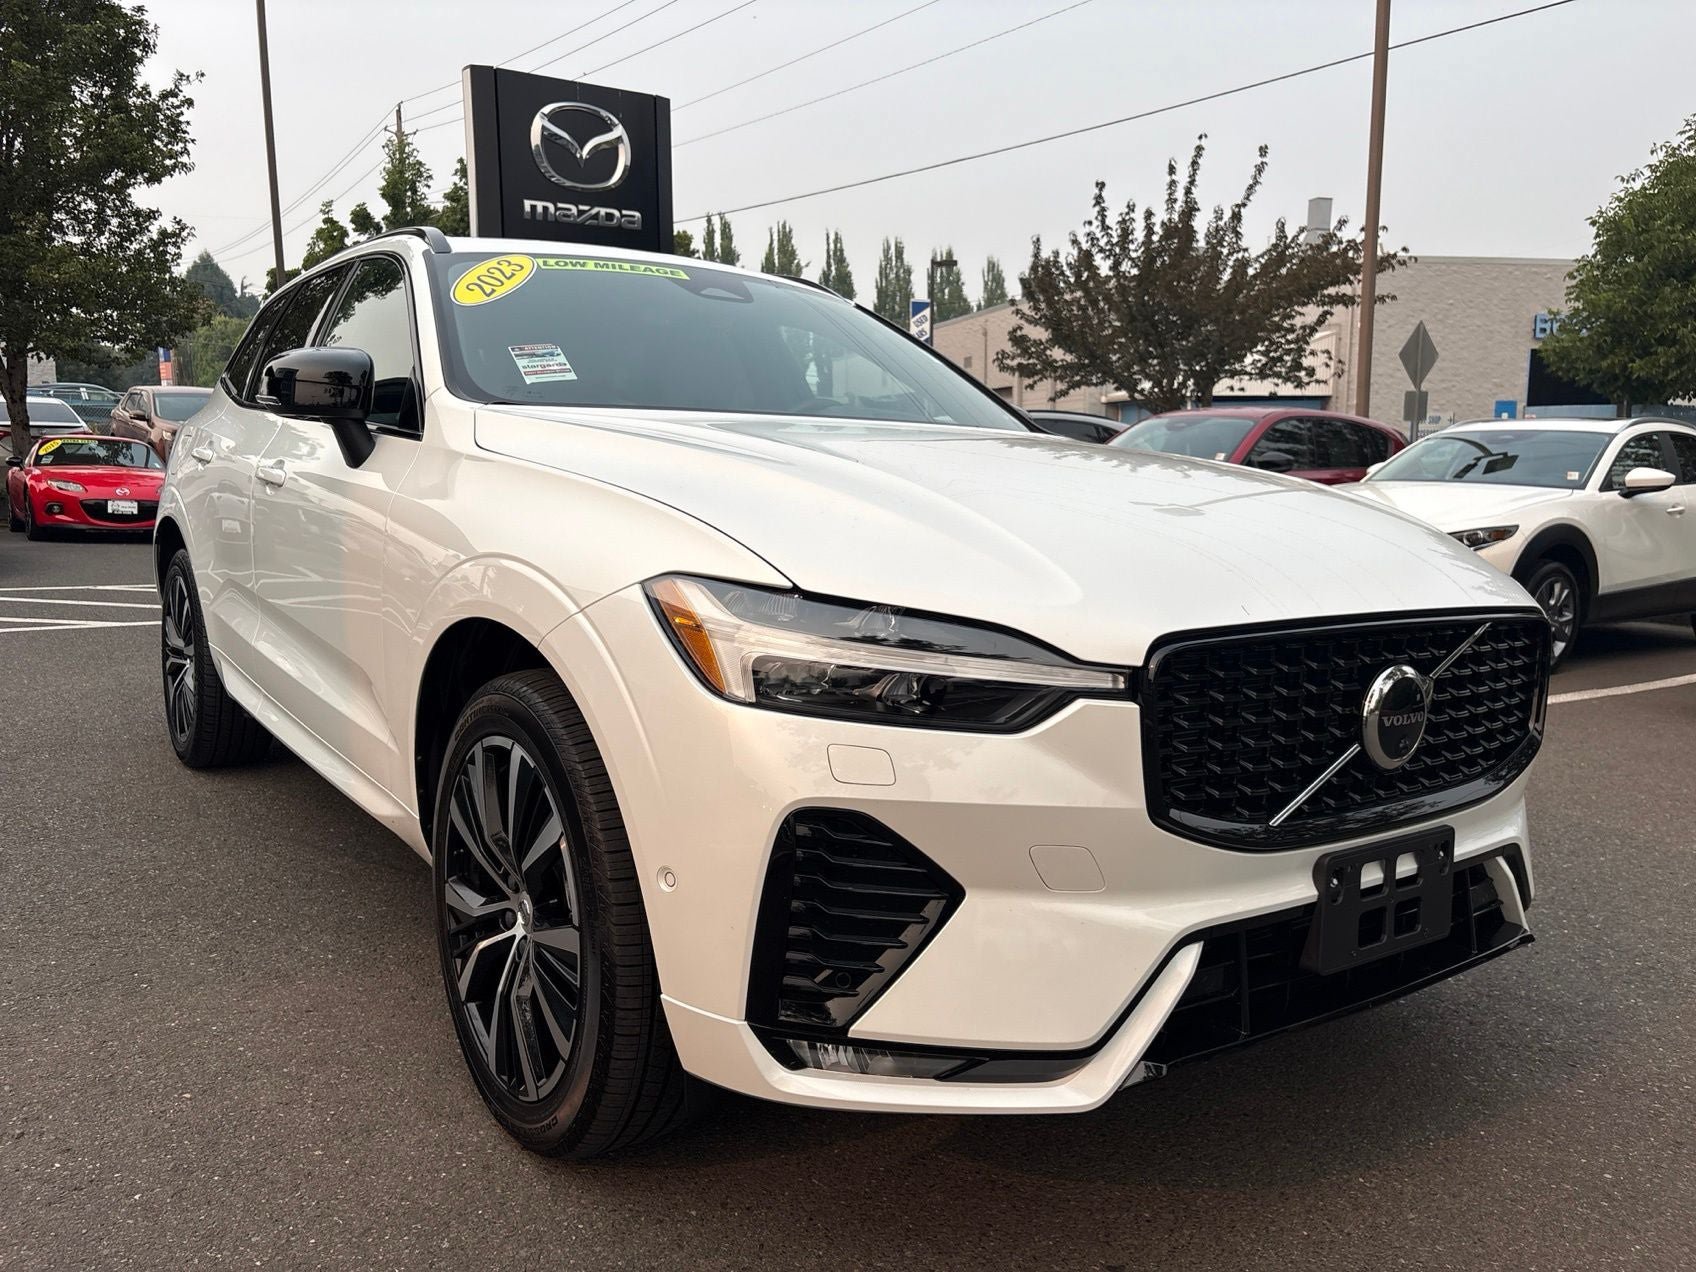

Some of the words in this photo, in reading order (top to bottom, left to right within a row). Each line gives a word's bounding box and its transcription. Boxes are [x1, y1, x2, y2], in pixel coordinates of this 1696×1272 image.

[542, 260, 587, 269] LOW
[593, 261, 683, 277] MILEAGE
[466, 259, 524, 297] 2023
[1382, 711, 1424, 727] VOLVO
